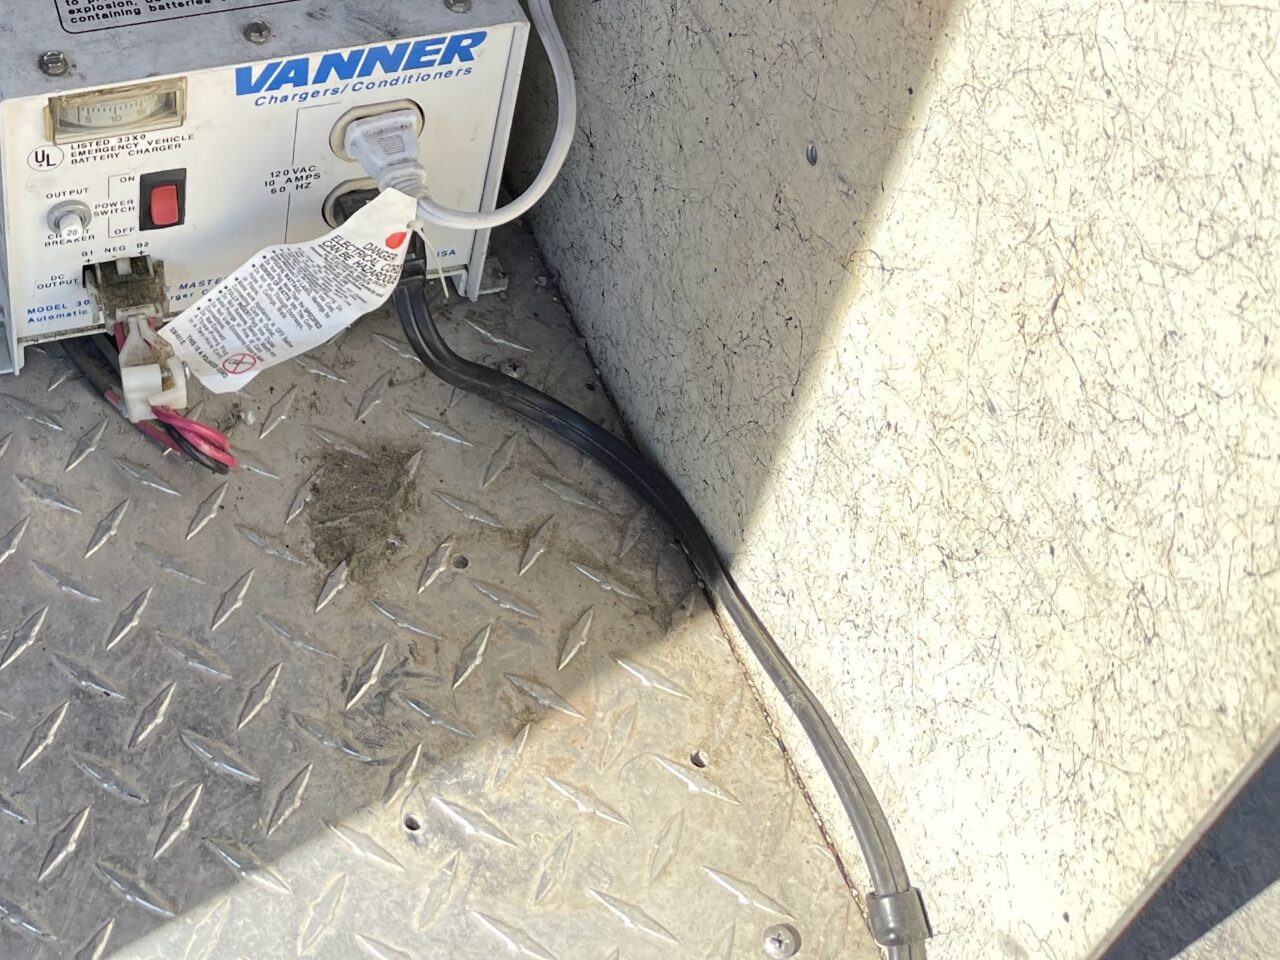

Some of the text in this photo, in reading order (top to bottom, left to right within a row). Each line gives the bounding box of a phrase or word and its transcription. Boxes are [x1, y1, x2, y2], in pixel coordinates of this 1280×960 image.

[68, 0, 137, 14] explosion,
[71, 6, 141, 23] containing
[235, 31, 487, 96] VANNER
[255, 67, 472, 107] Chargers/Conditioners
[71, 140, 110, 150] LISTED
[71, 134, 195, 157] EMERGENCY VEHICLE
[35, 150, 56, 166] UL
[71, 143, 181, 164] BATTERY CHARGER
[292, 165, 316, 174] VAC
[286, 173, 321, 184] AMPS
[46, 188, 89, 198] OUTPUT
[295, 182, 311, 190] HZ
[95, 199, 134, 209] POWER
[93, 206, 135, 217] SWITCH
[45, 234, 95, 247] BREAKER
[322, 239, 342, 253] CAN
[338, 249, 354, 261] BE
[330, 234, 380, 266] ELECTRICAL
[363, 242, 396, 262] DANGER
[37, 279, 78, 289] OUTPUT
[27, 303, 69, 315] MODEL
[27, 309, 88, 324] Automatic
